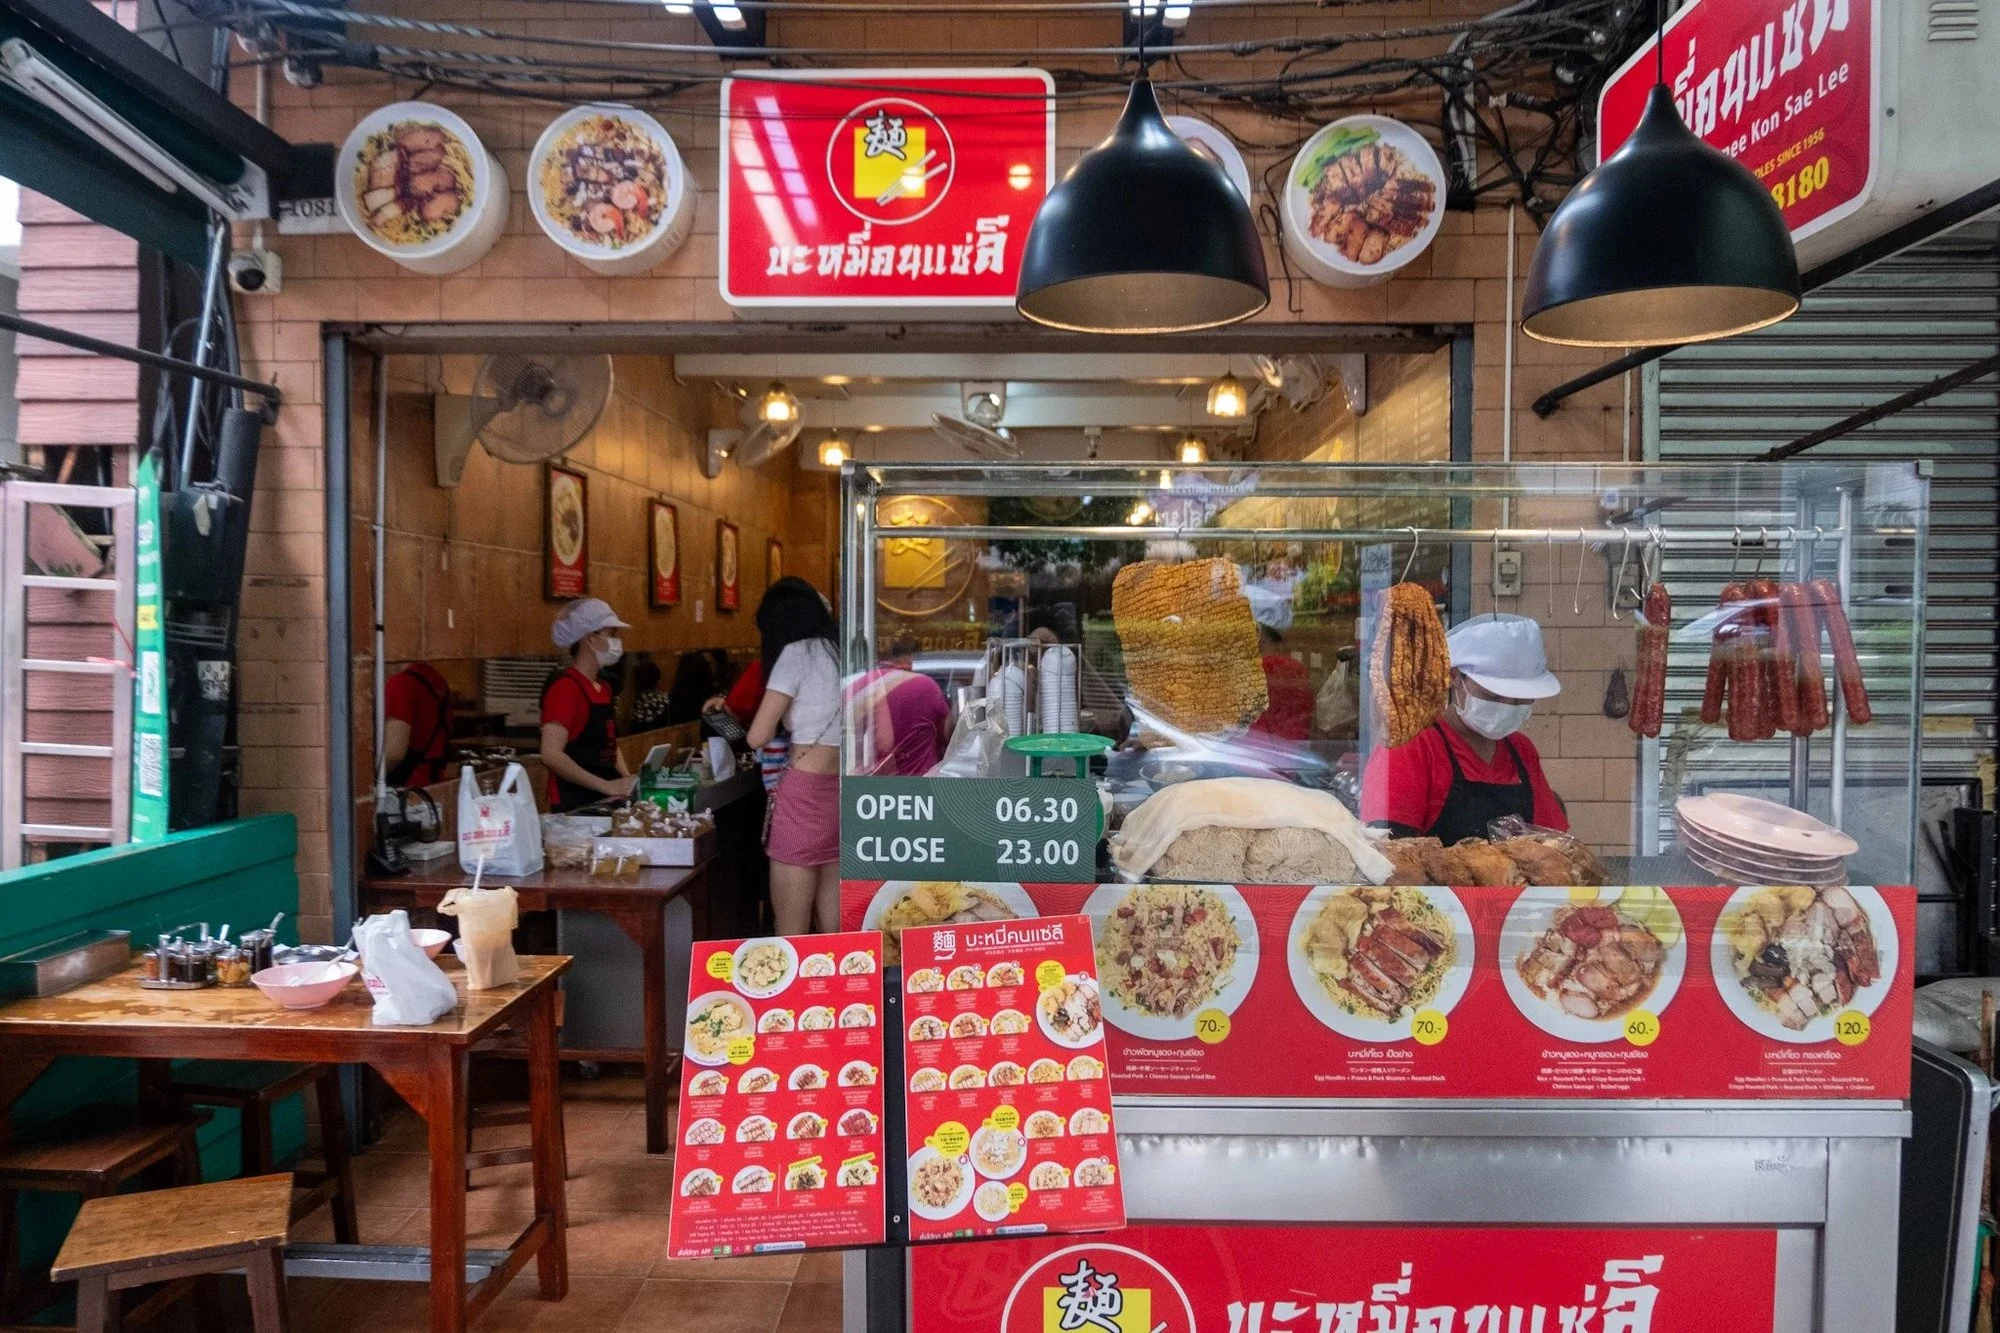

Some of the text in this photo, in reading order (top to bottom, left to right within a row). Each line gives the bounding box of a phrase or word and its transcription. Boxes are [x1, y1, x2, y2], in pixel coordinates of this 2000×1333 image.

[1751, 111, 1780, 145] Kon
[1784, 88, 1813, 122] Sae
[1818, 63, 1849, 99] Lee
[1776, 141, 1801, 168] SINCE
[1803, 127, 1825, 150] 1956
[856, 794, 1078, 822] OPEN 06.30
[856, 836, 1079, 865] CLOSE 23.00
[966, 923, 1064, 947] บะหมี่คนแซ่ลี
[1199, 1019, 1225, 1032] 70.-
[1416, 1020, 1442, 1034] 70.-
